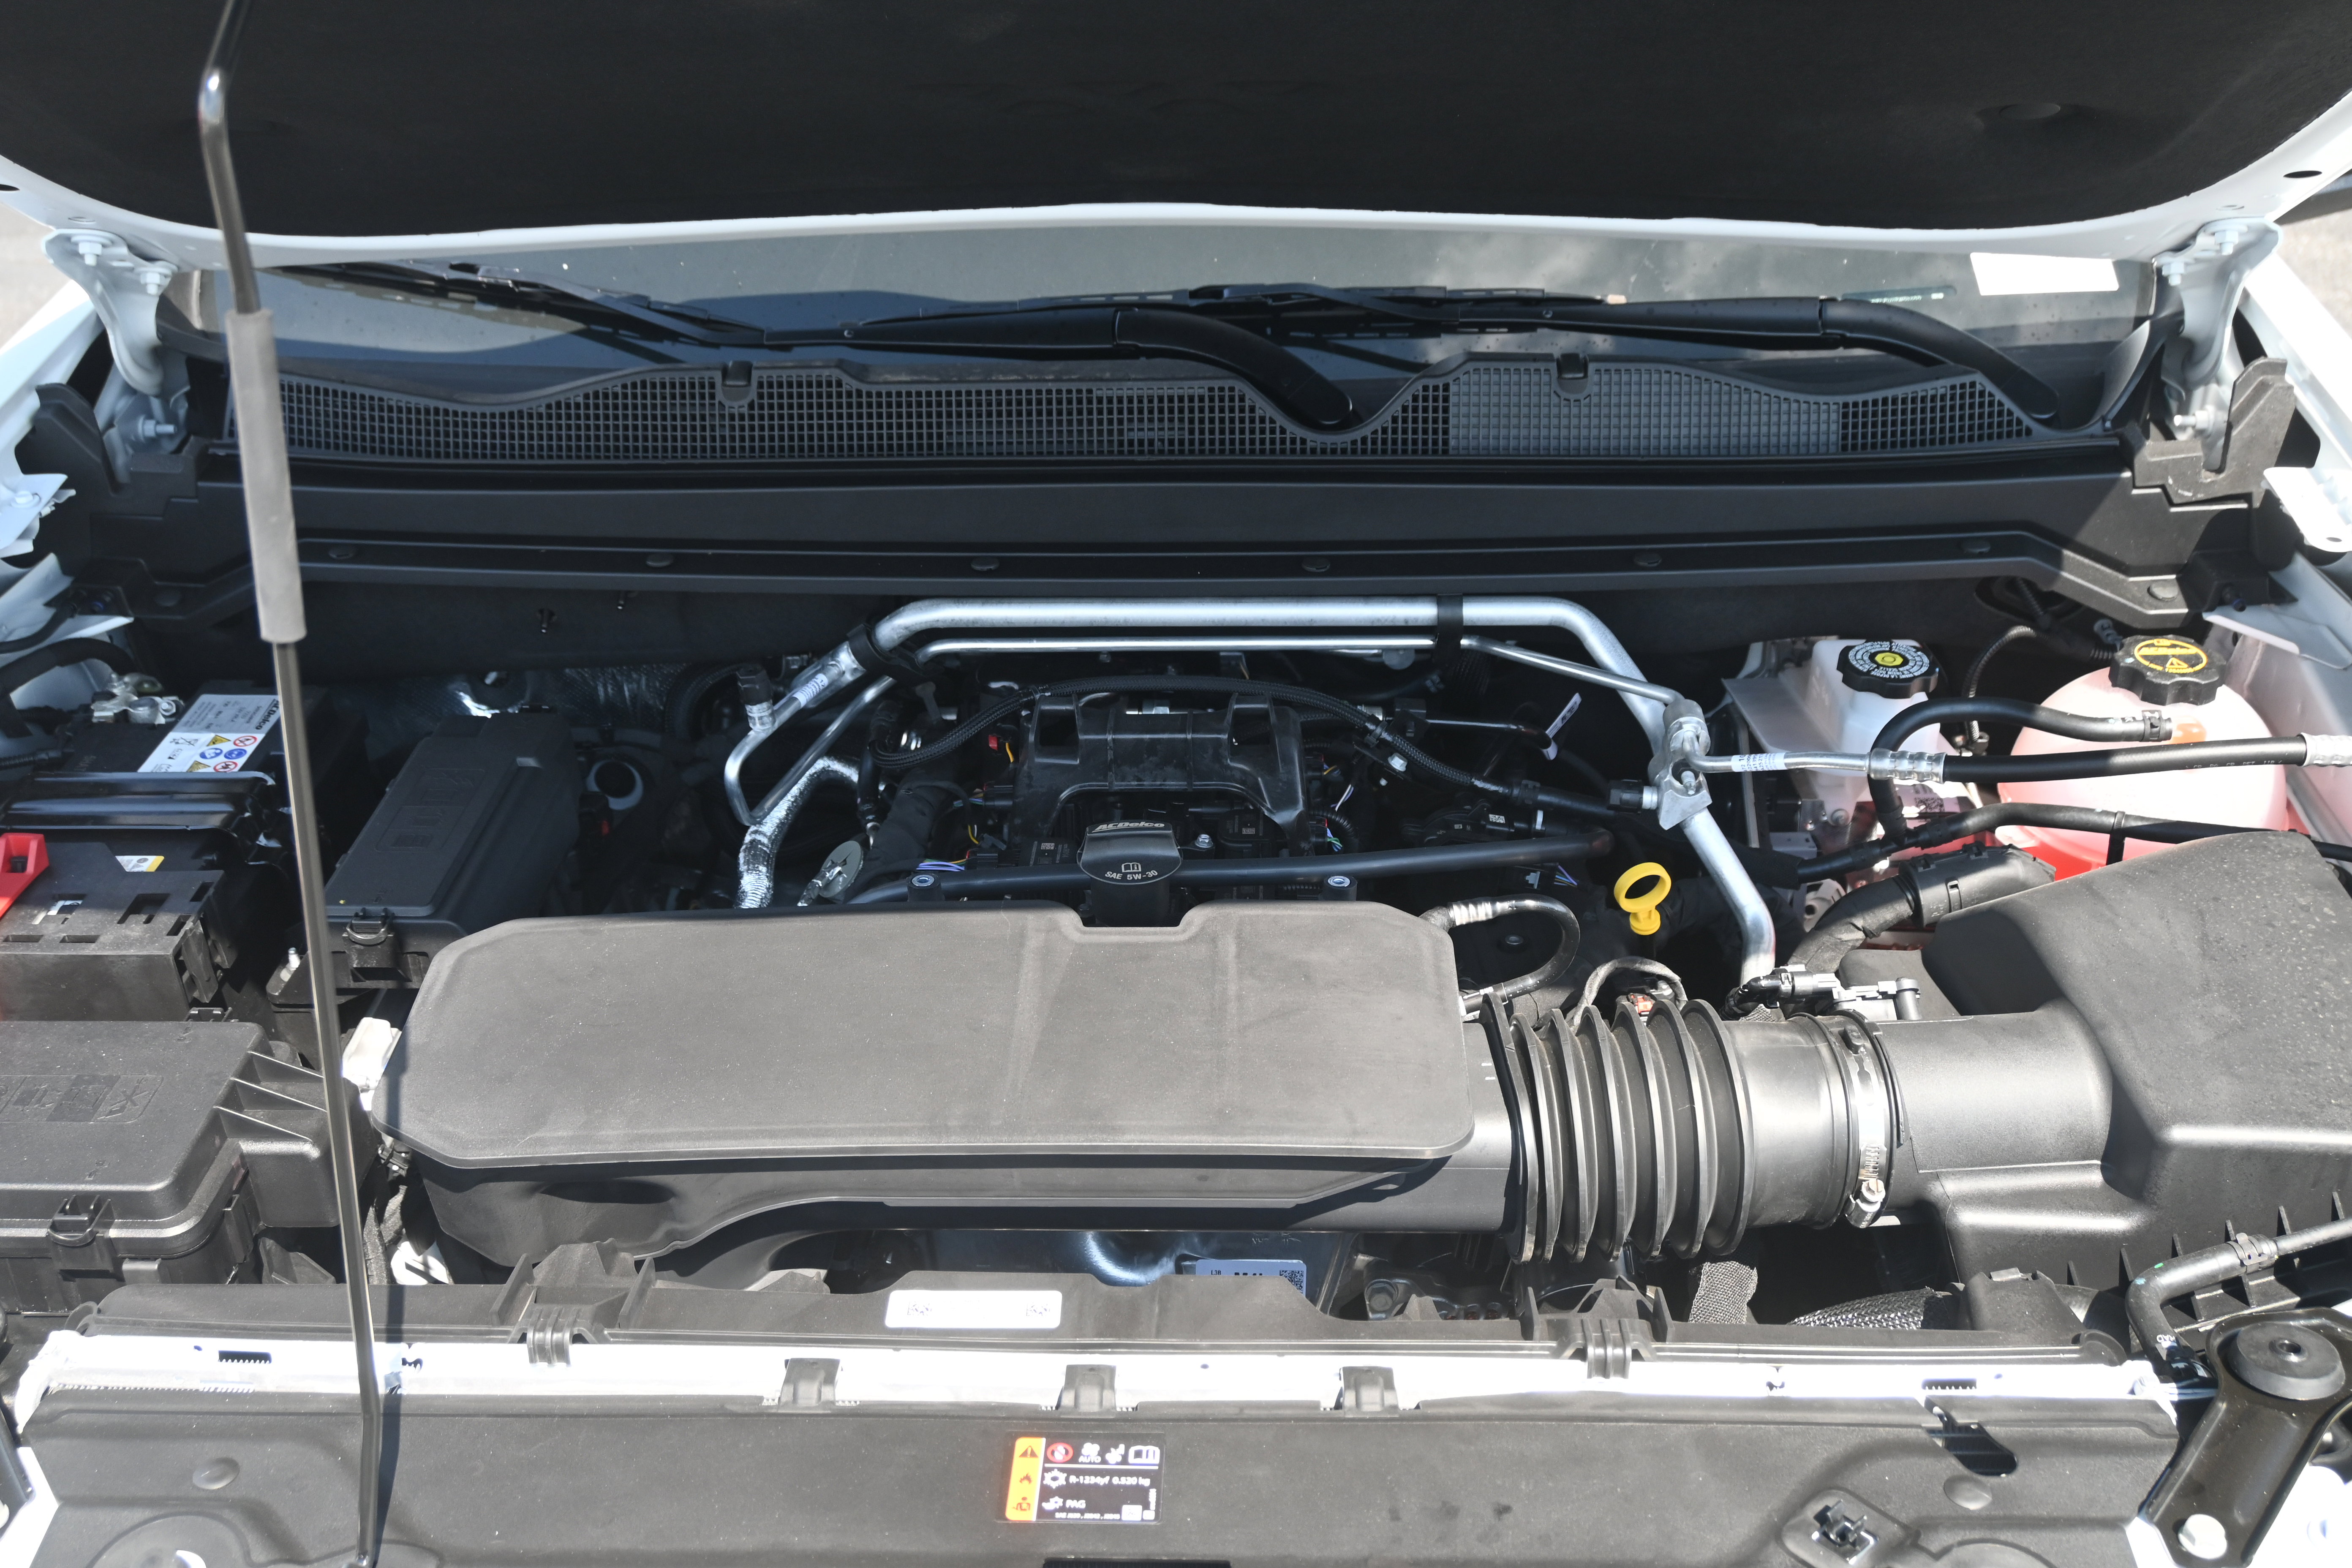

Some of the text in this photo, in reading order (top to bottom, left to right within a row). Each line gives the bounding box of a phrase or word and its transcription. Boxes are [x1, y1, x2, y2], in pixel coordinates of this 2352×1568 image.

[1093, 822, 1165, 832] ACDelco
[1105, 870, 1158, 880] SAE 5W-30
[1069, 1475, 1109, 1486] R-1234yf
[1138, 1477, 1150, 1486] kg
[1066, 1500, 1086, 1508] PAG
